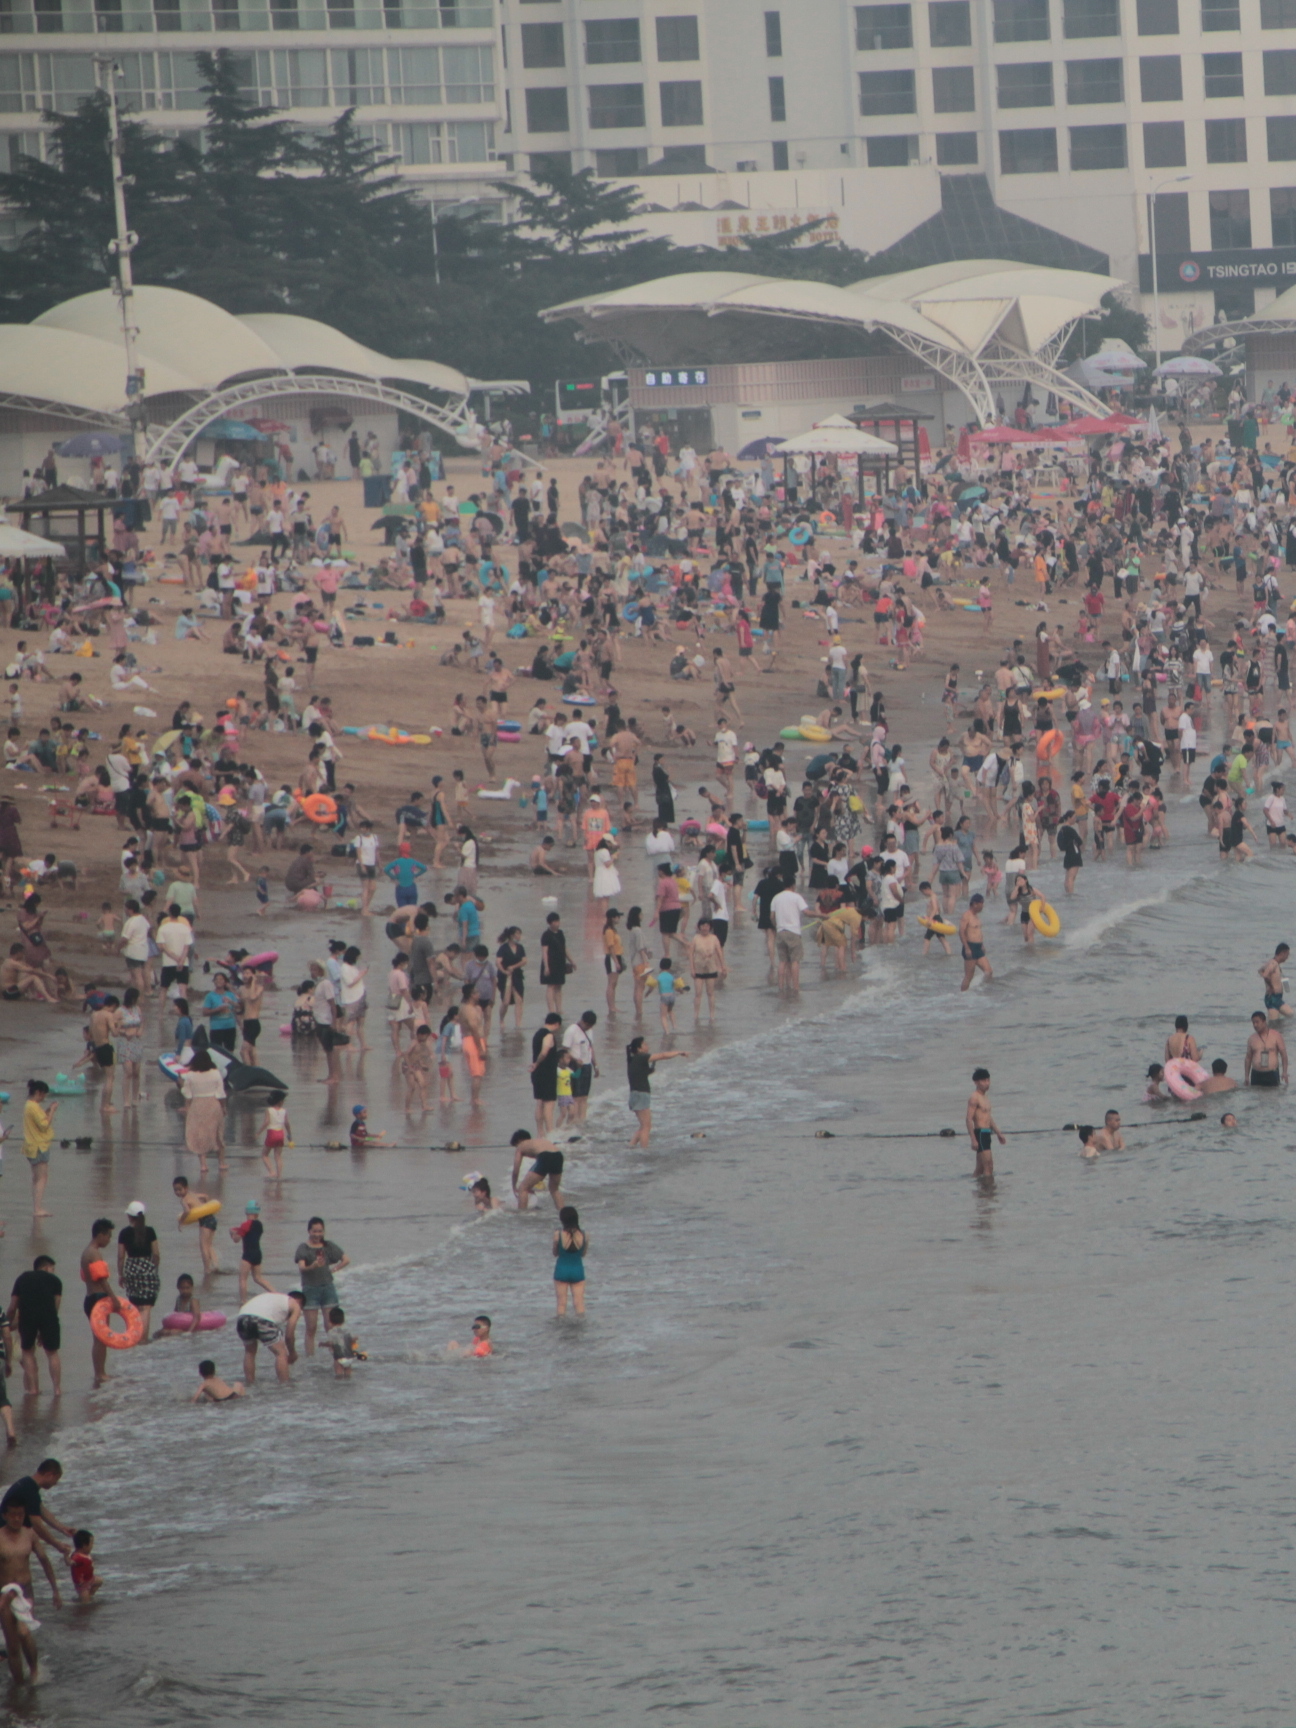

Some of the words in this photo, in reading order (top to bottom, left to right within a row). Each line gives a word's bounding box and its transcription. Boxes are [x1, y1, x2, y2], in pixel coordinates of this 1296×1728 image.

[1207, 263, 1278, 279] TSINGTAO
[645, 370, 705, 386] 自助寄存
